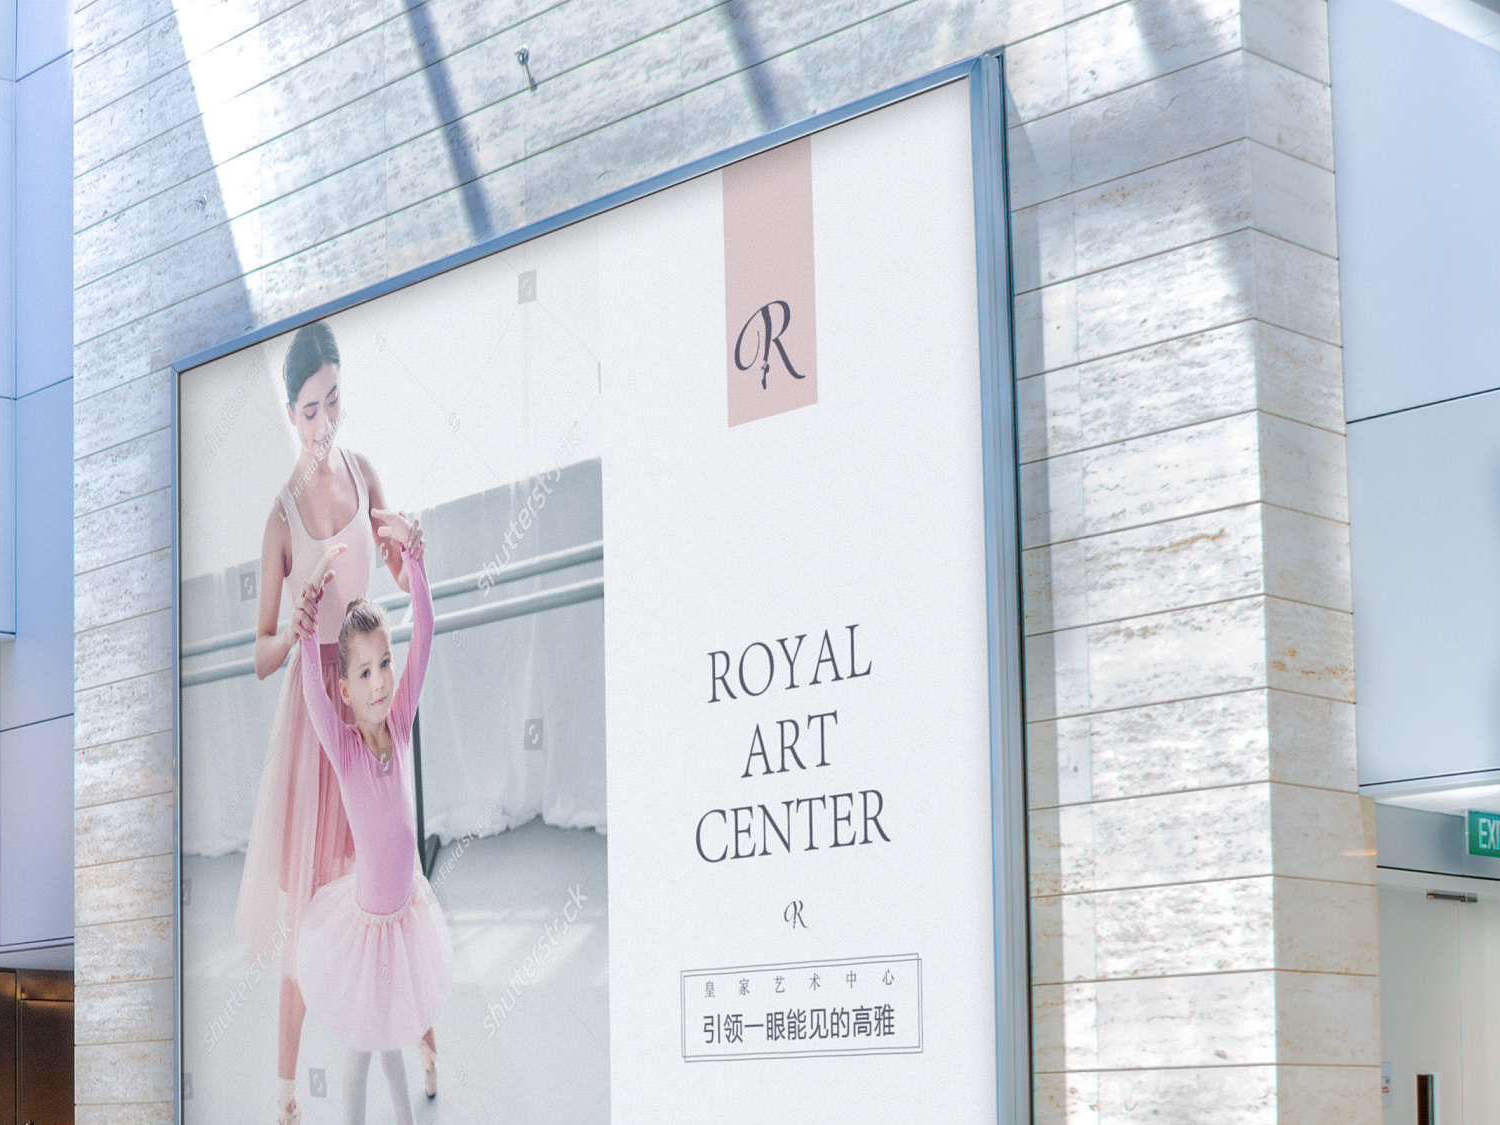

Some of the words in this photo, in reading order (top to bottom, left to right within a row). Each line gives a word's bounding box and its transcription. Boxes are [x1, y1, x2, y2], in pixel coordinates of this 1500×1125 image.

[707, 624, 872, 703] ROYAL
[741, 710, 838, 778] ART
[695, 789, 891, 863] CENTER
[1478, 817, 1500, 850] EXI
[704, 968, 895, 999] 皇家艺术中心
[703, 1003, 896, 1045] 引领一眼能见的高雅
